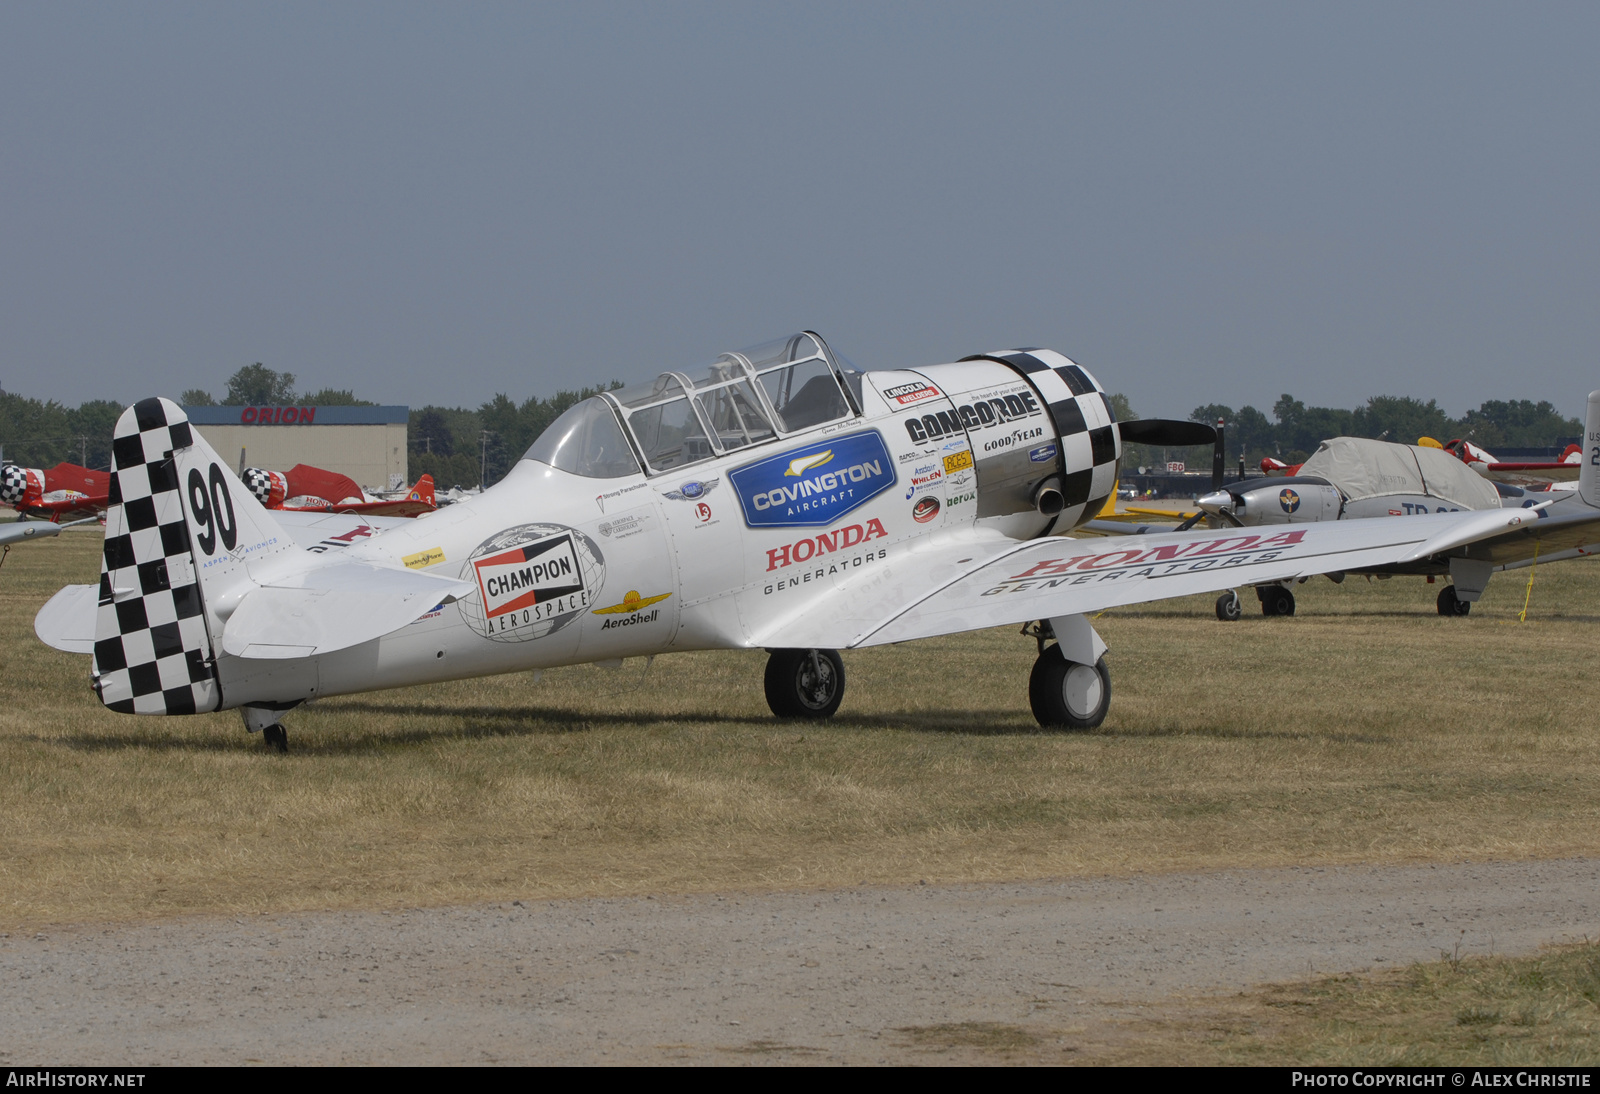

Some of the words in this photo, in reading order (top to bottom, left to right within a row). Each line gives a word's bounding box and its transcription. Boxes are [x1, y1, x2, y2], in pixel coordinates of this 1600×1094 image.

[886, 382, 926, 398] LINCOLN
[900, 389, 935, 403] WELDERS
[241, 407, 316, 423] ORION
[904, 391, 1042, 446] CONCORDE
[984, 427, 1043, 451] GOODYEAR
[946, 453, 967, 470] ACES
[1168, 463, 1184, 471] FBO
[603, 491, 620, 499] Strong
[620, 482, 648, 494] Parachutes
[752, 459, 883, 511] COVINGTON
[188, 462, 237, 556] 90
[787, 489, 854, 516] AIRCRAFT
[947, 491, 976, 508] aerox
[612, 515, 634, 526] AEROSPACE
[203, 556, 228, 569] ASPEN
[245, 538, 277, 553] AVIONICS
[766, 517, 888, 572] HONDA
[1009, 529, 1308, 579] HONDA
[487, 556, 572, 597] CHAMPION
[764, 549, 887, 595] GENERATORS
[979, 551, 1283, 596] GENERATORS
[488, 592, 587, 634] AEROSPACE
[601, 608, 658, 630] AeroShell
